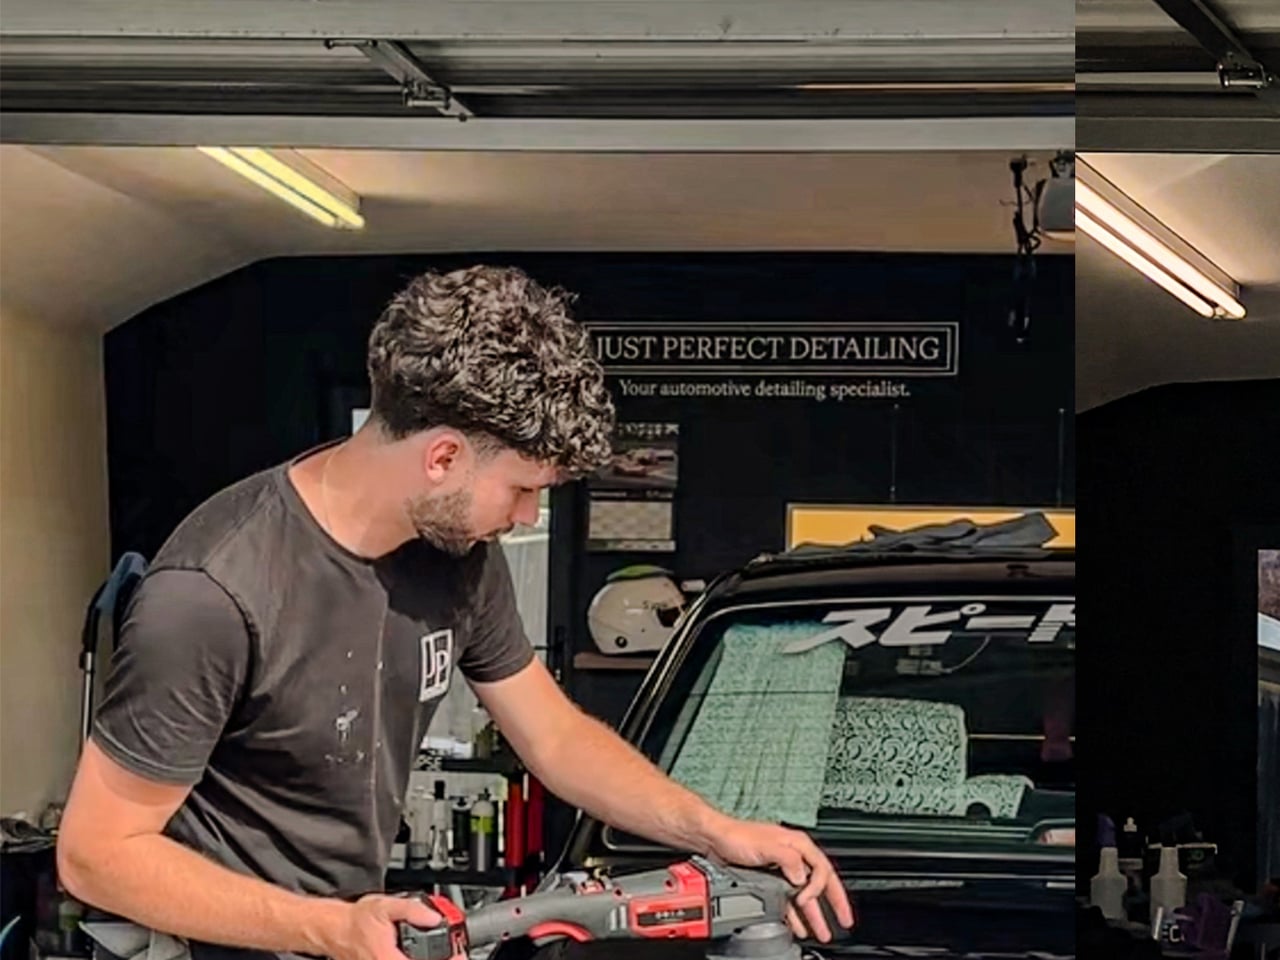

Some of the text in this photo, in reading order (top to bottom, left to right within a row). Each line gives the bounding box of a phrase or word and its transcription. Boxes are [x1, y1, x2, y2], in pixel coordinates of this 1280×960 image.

[597, 336, 940, 361] JUST PERFECT DETAILING
[619, 379, 911, 400] Your automotive detailing specialist.
